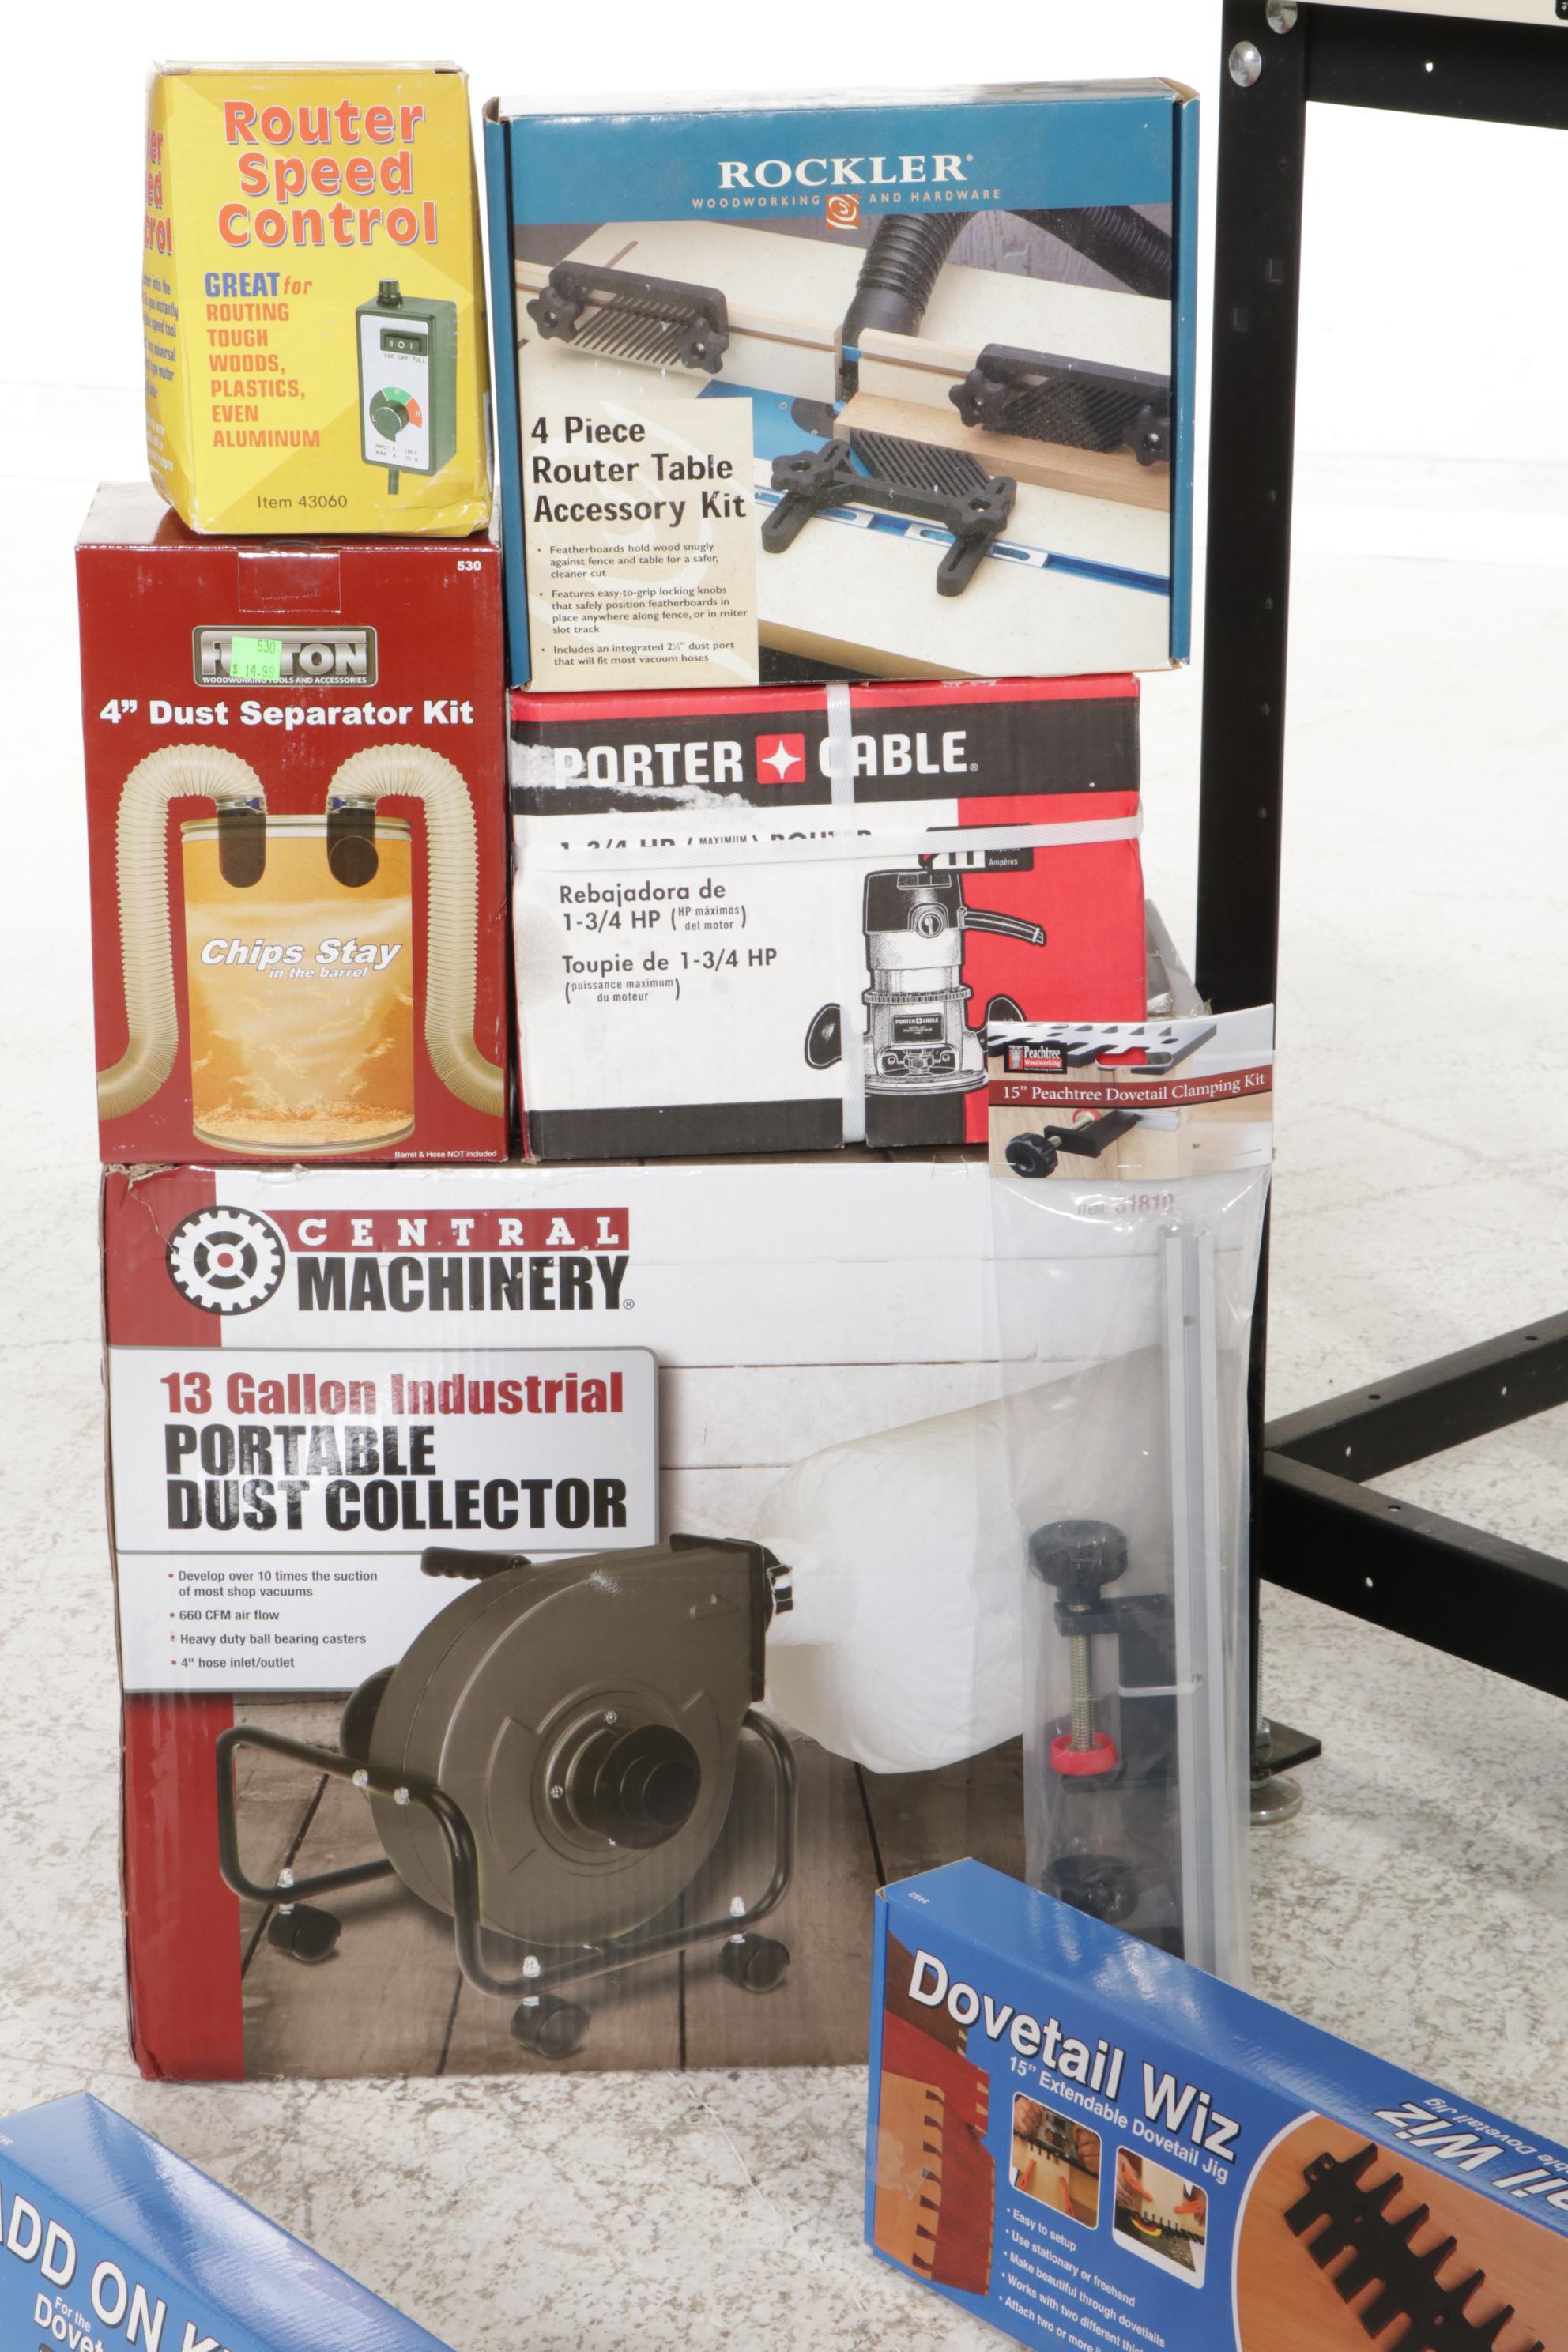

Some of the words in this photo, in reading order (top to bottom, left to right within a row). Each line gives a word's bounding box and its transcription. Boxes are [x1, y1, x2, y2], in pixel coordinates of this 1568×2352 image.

[224, 100, 426, 145] Router
[238, 150, 413, 203] Speed
[718, 154, 967, 188] ROCKLER
[692, 195, 820, 209] WOODWORKING
[870, 193, 901, 203] AND
[911, 189, 1001, 202] HARDWARE
[217, 201, 439, 247] Control
[205, 273, 280, 297] GREAT
[284, 276, 312, 295] for
[206, 303, 289, 321] ROUTING
[207, 329, 268, 347] TOUGH
[209, 355, 285, 375] WOODS,
[211, 379, 305, 400] PLASTICS,
[212, 405, 258, 422] EVEN
[213, 430, 321, 447] ALUMINUM
[531, 416, 548, 443] 4
[565, 416, 645, 443] Piece
[533, 456, 639, 483] Router
[651, 453, 733, 481] Table
[258, 495, 292, 508] Item
[298, 495, 347, 508] 43060
[534, 495, 685, 527] Accessory
[702, 491, 746, 518] Kit
[550, 545, 624, 554] Featherboards
[628, 544, 650, 552] hold
[653, 543, 680, 552] wood
[684, 543, 714, 552] snugly
[551, 557, 585, 567] against
[588, 556, 615, 565] fence
[639, 556, 664, 564] table
[693, 555, 719, 564] safer,
[457, 560, 481, 571] 530
[552, 590, 594, 598] Features
[598, 588, 656, 598] easy-to-grip
[660, 587, 695, 597] locking
[697, 586, 727, 594] knobs
[575, 601, 602, 611] safely
[606, 600, 645, 609] position
[648, 598, 718, 607] featherboards
[553, 613, 579, 624] place
[582, 612, 629, 623] anywhere
[632, 612, 659, 621] along
[662, 610, 692, 620] fence,
[258, 639, 276, 654] 530
[554, 645, 594, 654] Includes
[612, 643, 664, 654] integrated
[713, 641, 735, 650] port
[149, 700, 229, 726] Dust
[240, 699, 413, 731] Separator
[424, 699, 474, 725] Kit
[554, 741, 744, 789] PORTER
[989, 858, 1019, 867] Ampères
[560, 880, 690, 907] Rebajadora
[699, 878, 726, 899] de
[564, 910, 622, 933] 1-3/4
[632, 910, 661, 929] HP
[201, 938, 304, 971] Chips
[315, 938, 402, 971] Stay
[562, 954, 633, 978] Toupie
[643, 951, 669, 971] de
[681, 948, 739, 971] 1-3/4
[748, 948, 777, 967] HP
[269, 967, 283, 978] in
[289, 967, 315, 978] the
[319, 967, 368, 978] barrel
[1024, 1046, 1061, 1059] Peachtree
[1032, 1086, 1102, 1102] Peachtree
[1106, 1087, 1167, 1101] Dovetail
[1172, 1079, 1241, 1099] Clamping
[1245, 1073, 1265, 1087] Kit
[297, 1216, 620, 1246] CENTRAL
[297, 1254, 629, 1312] MACHINERY
[160, 1371, 212, 1414] 13
[226, 1371, 376, 1415] Gallon
[391, 1371, 624, 1415] Industrial
[164, 1424, 436, 1476] PORTABLE
[168, 1479, 309, 1532] DUST
[325, 1479, 627, 1532] COLLECTOR
[179, 1571, 224, 1583] Develop
[228, 1573, 254, 1581] over
[258, 1571, 272, 1581] 10
[276, 1570, 307, 1581] times
[311, 1570, 330, 1581] the
[334, 1570, 378, 1581] suction
[179, 1586, 190, 1596] of
[194, 1587, 224, 1596] most
[228, 1586, 256, 1598] shop
[259, 1588, 313, 1596] vacuums
[179, 1610, 202, 1620] 660
[205, 1610, 232, 1620] CFM
[235, 1610, 251, 1620] air
[254, 1610, 280, 1620] flow
[180, 1634, 217, 1645] Heavy
[220, 1634, 246, 1645] duty
[250, 1634, 271, 1644] ball
[274, 1634, 319, 1645] bearing
[322, 1634, 367, 1644] casters
[198, 1657, 227, 1668] hose
[230, 1657, 295, 1668] inlet/outlet
[908, 1948, 1126, 2102] Dovetail
[1141, 2060, 1242, 2164] Wiz
[1039, 2071, 1128, 2128] Extendable
[1131, 2118, 1199, 2168] Dovetail
[1203, 2154, 1228, 2186] Jig
[1373, 2101, 1506, 2172] Wiz
[1012, 2208, 1036, 2231] Easy
[1038, 2222, 1048, 2236] to
[1050, 2230, 1077, 2252] setup
[1012, 2230, 1030, 2248] Use
[1031, 2241, 1079, 2277] stationary
[1080, 2270, 1091, 2282] or
[1093, 2275, 1136, 2309] freehand
[1009, 2252, 1035, 2275] Make
[1036, 2266, 1077, 2298] beautiful
[1079, 2290, 1117, 2320] through
[54, 2296, 73, 2316] For
[75, 2311, 92, 2332] the
[91, 2260, 168, 2352] ON
